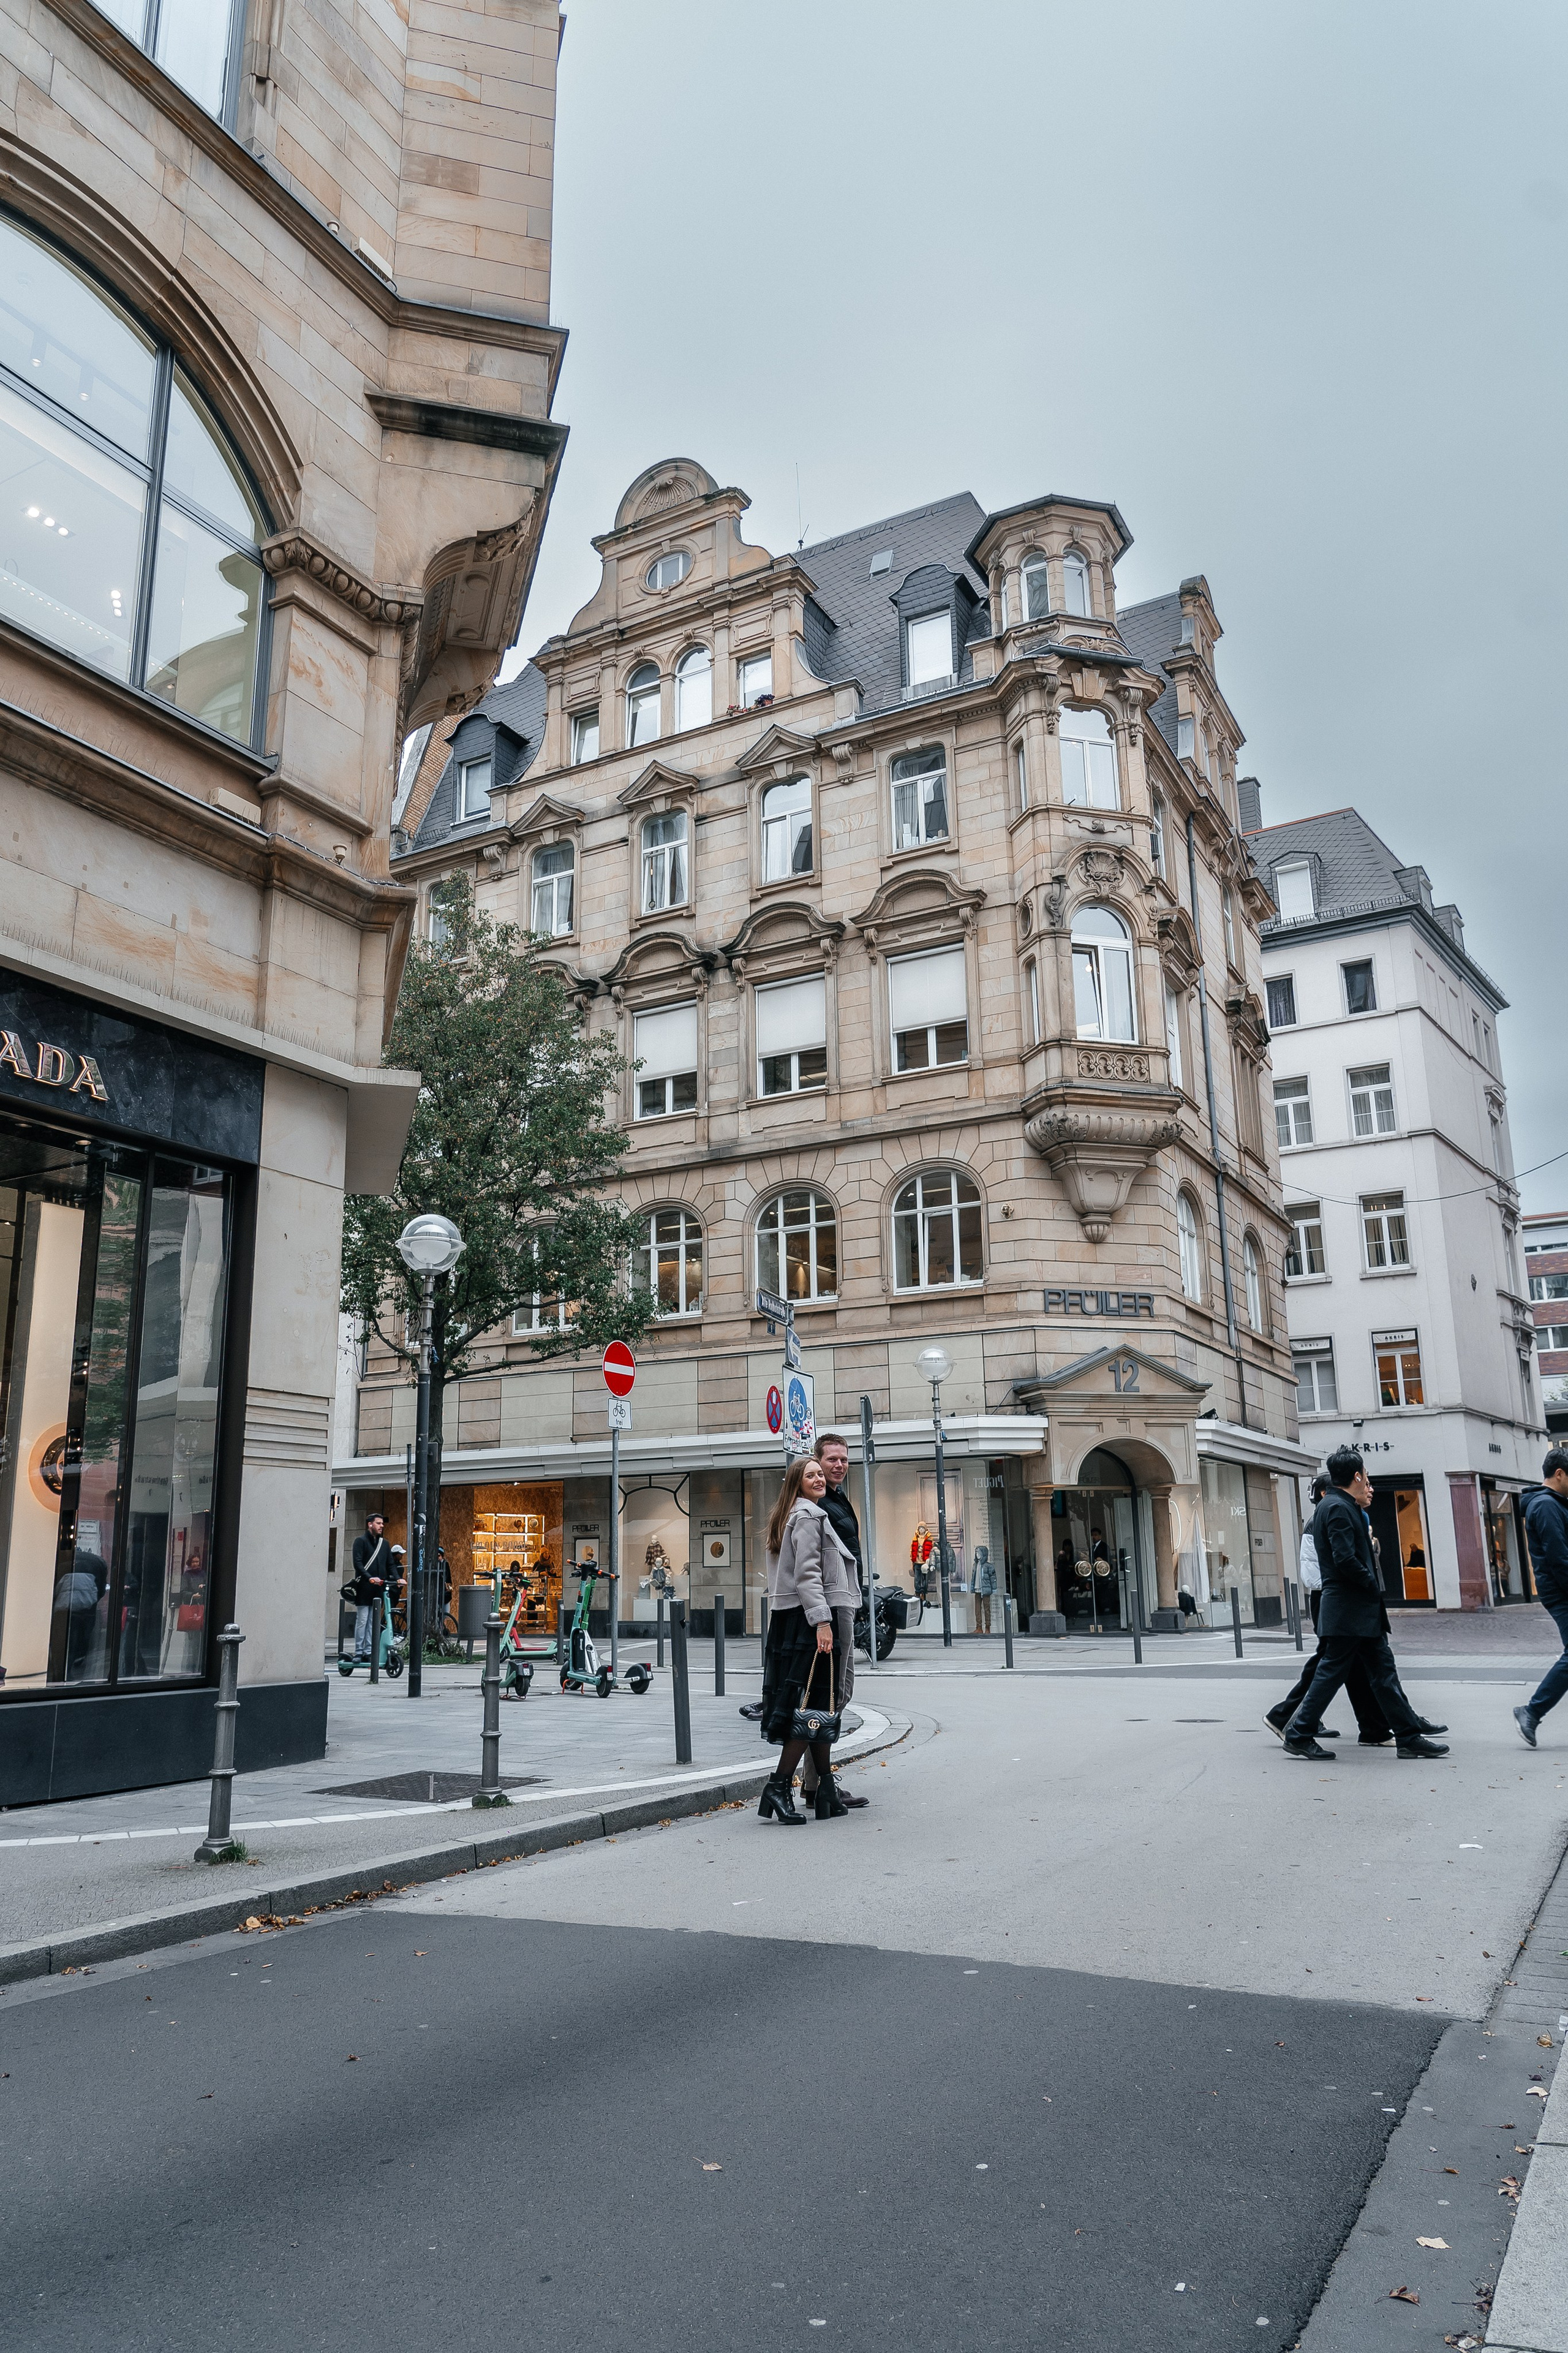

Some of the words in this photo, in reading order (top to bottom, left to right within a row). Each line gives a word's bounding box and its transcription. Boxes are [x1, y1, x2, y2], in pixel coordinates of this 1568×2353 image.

[0, 1030, 110, 1101] ADA
[1044, 1288, 1155, 1317] PFÜLLER
[1108, 1359, 1140, 1392] 12
